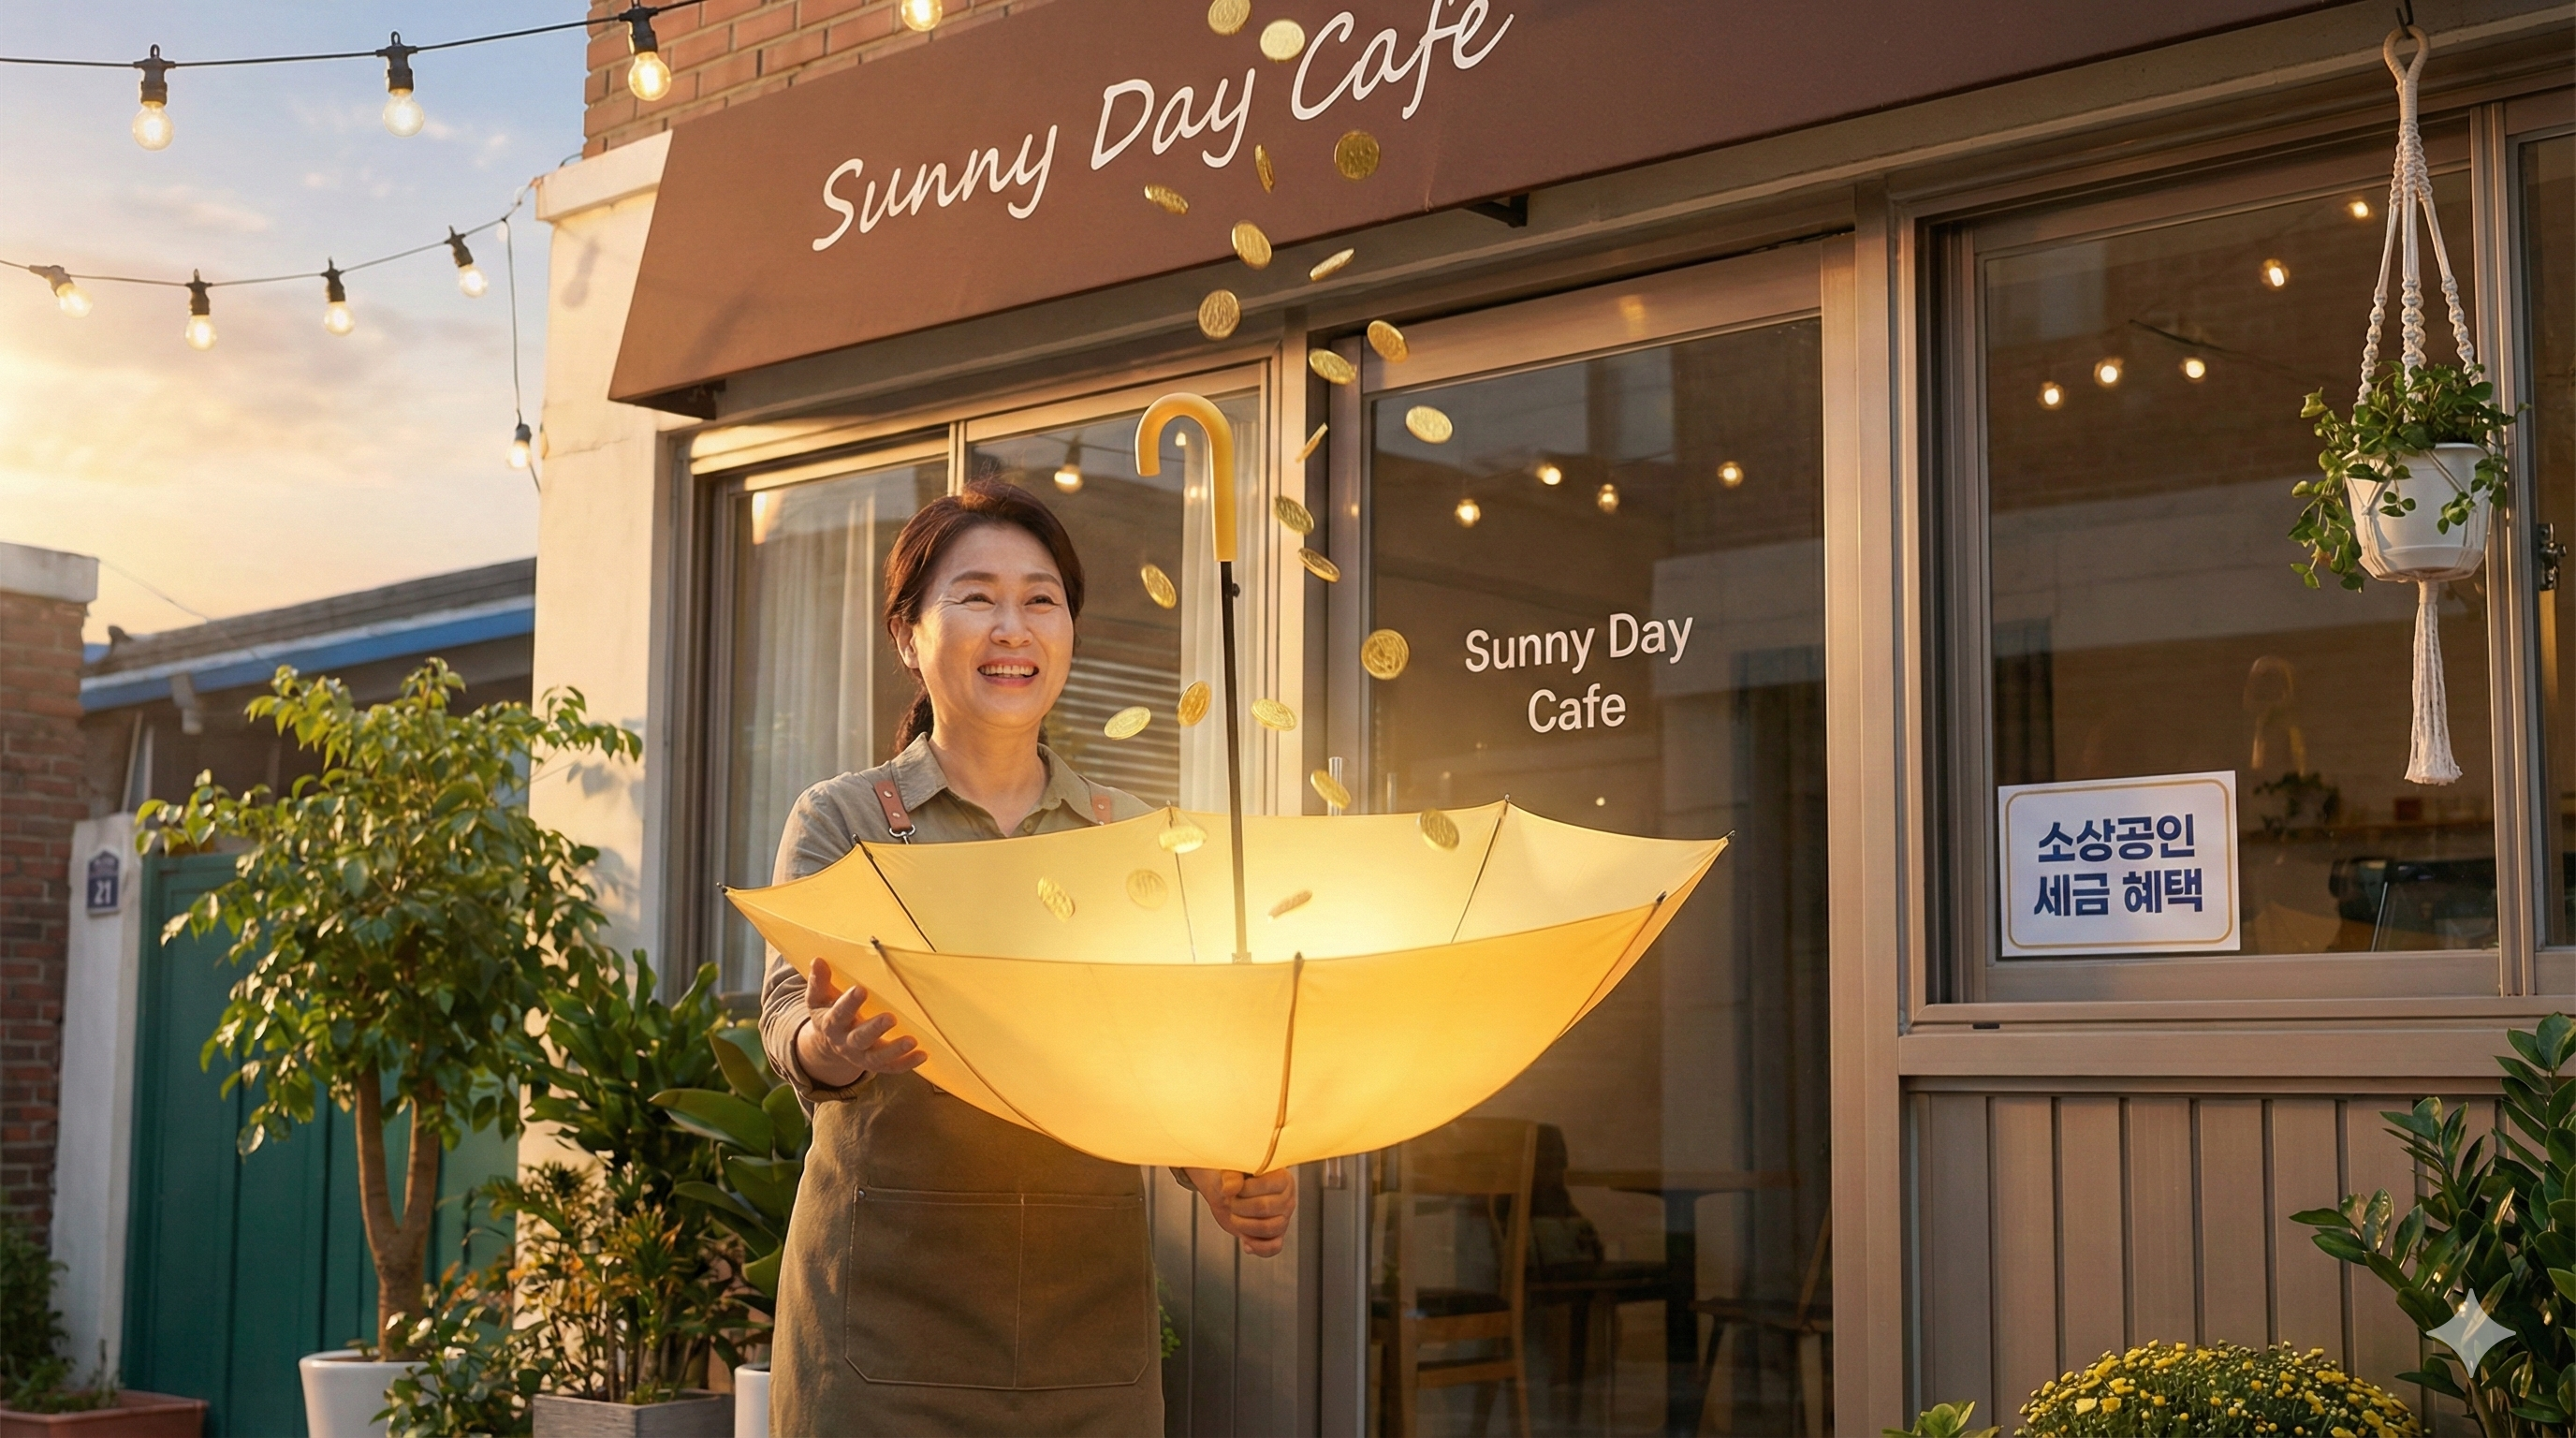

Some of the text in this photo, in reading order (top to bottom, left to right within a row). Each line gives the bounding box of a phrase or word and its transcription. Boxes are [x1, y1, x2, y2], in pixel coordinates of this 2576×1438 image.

[812, 125, 1058, 251] Sunny
[1090, 67, 1256, 170] Day
[1465, 612, 1693, 674] Sunny Day
[1528, 682, 1626, 733] Cafe
[2038, 814, 2195, 863] 소상공인
[94, 880, 111, 905] 21
[2033, 868, 2203, 917] 세금 혜택
